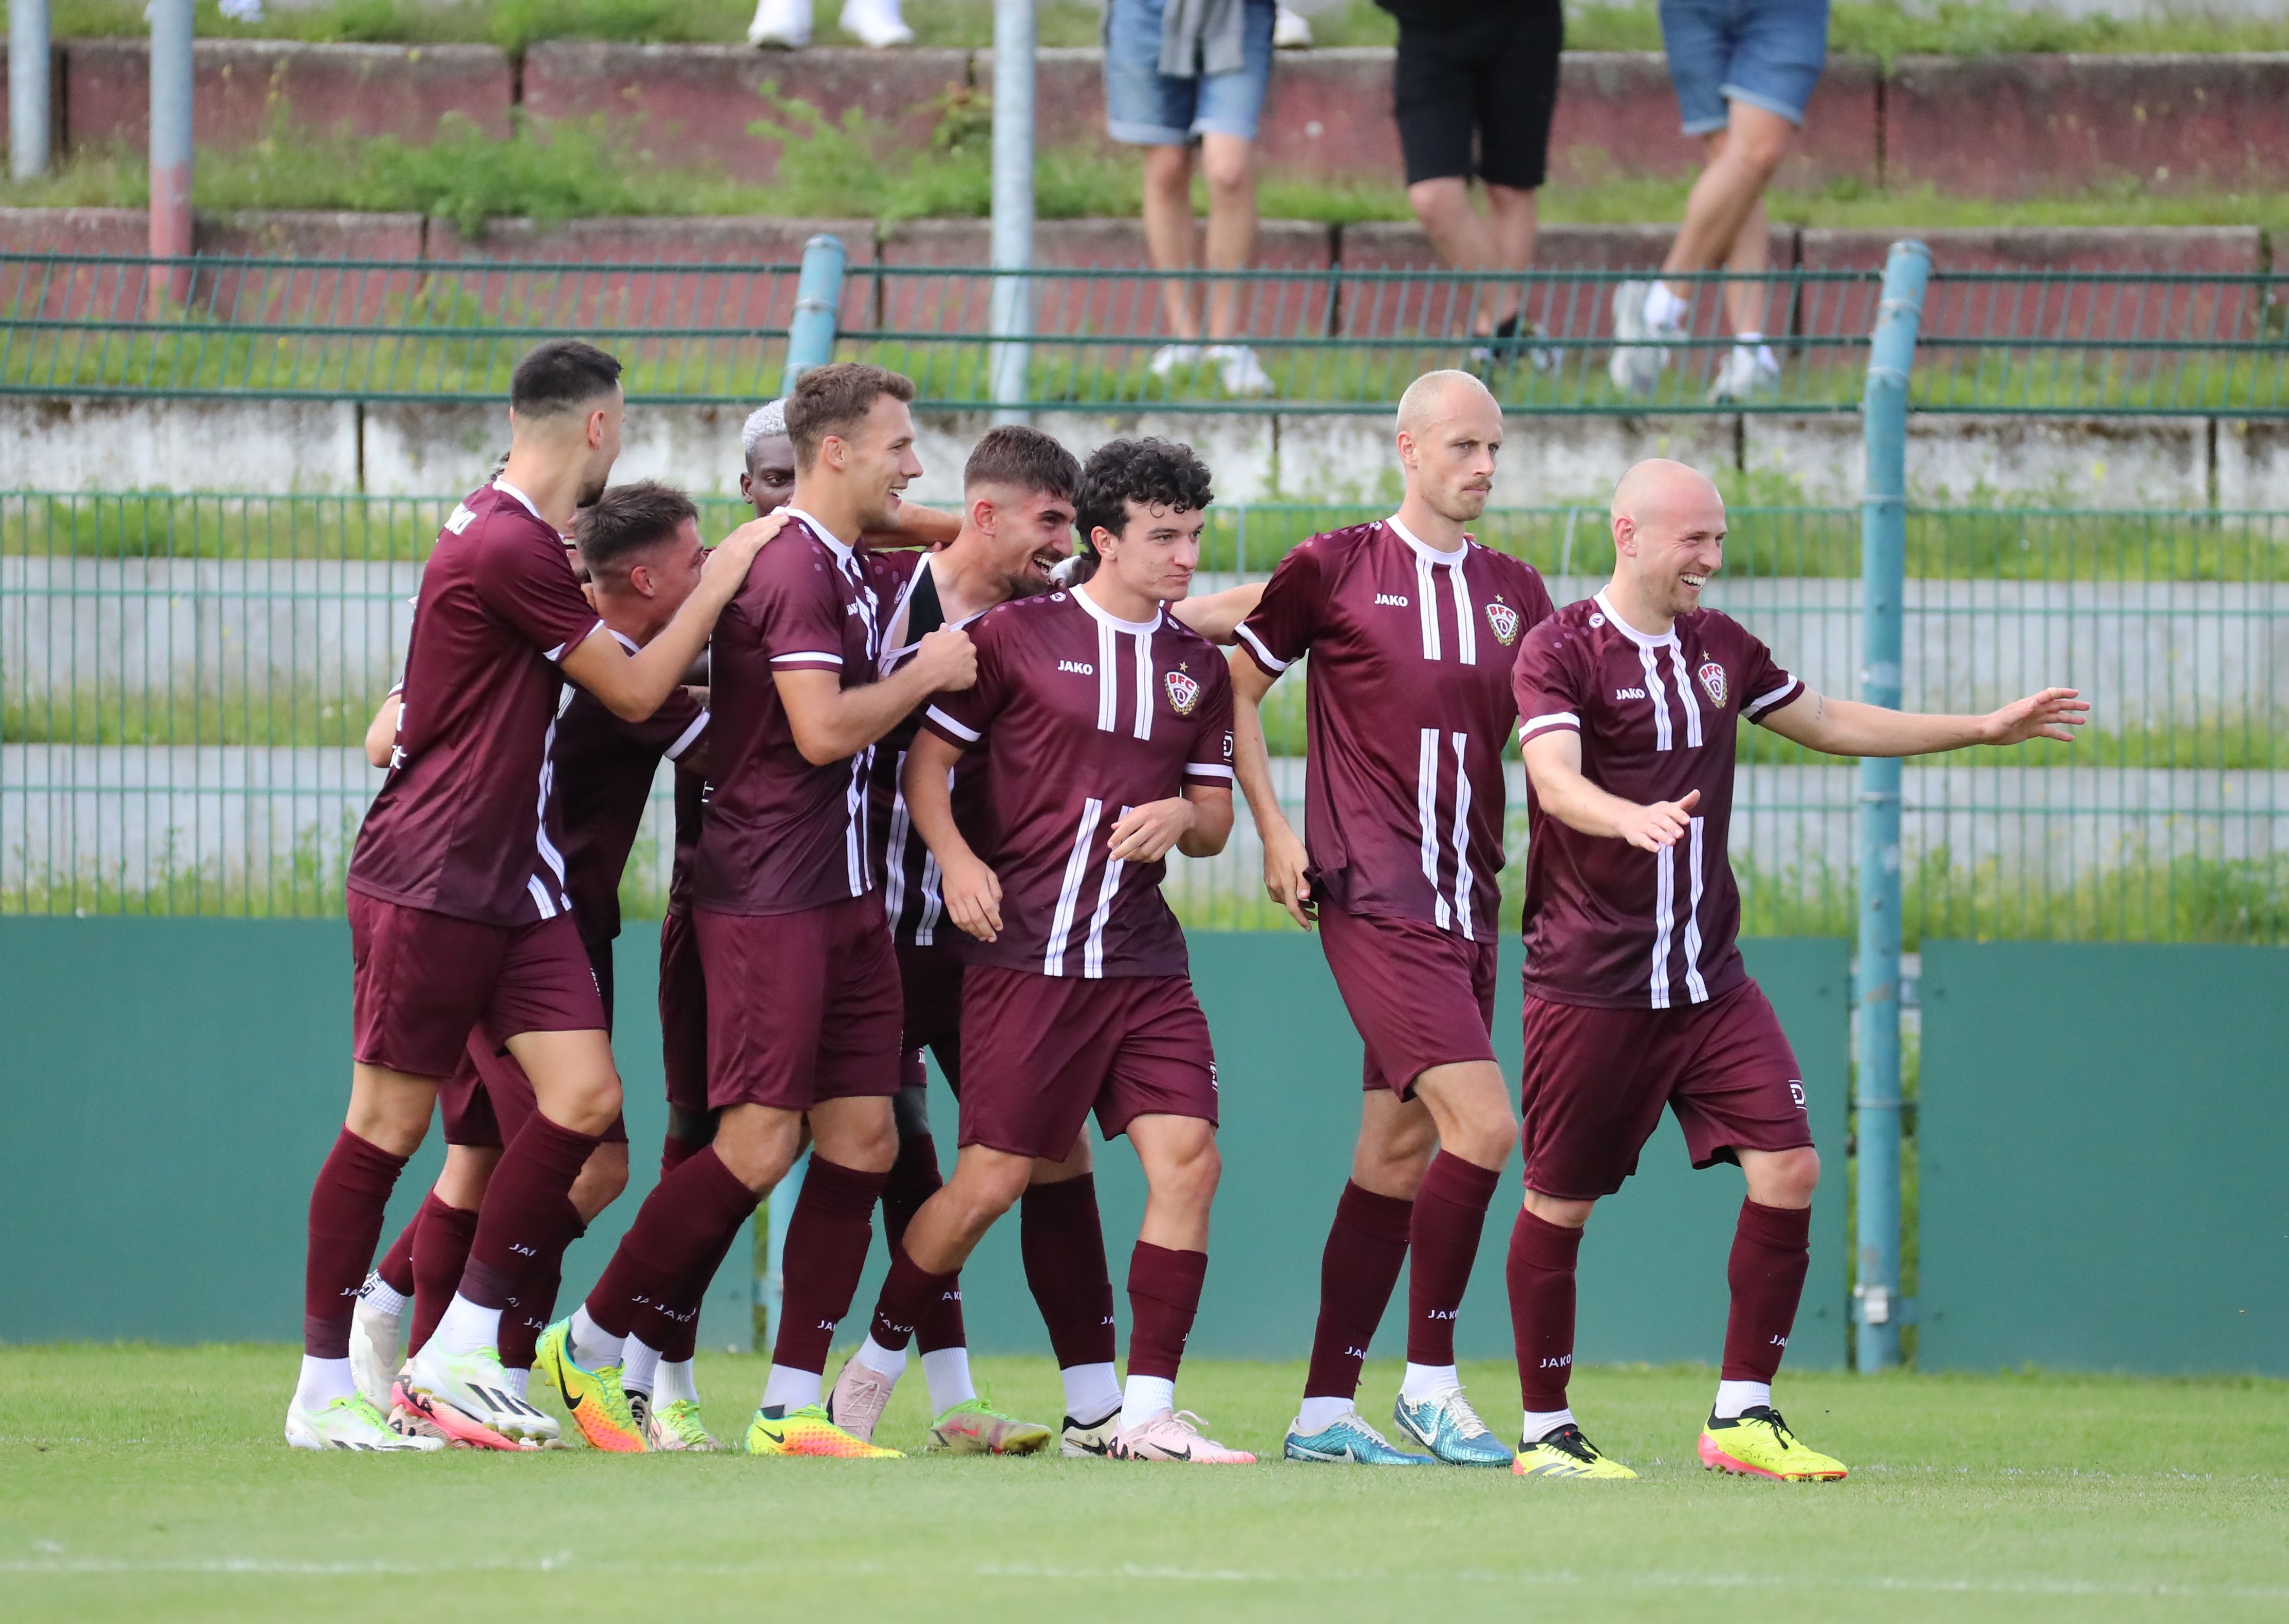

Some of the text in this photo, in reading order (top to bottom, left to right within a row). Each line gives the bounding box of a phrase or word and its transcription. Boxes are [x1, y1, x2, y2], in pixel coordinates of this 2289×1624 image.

[1374, 593, 1408, 607] JAKO
[1489, 606, 1514, 621] BFC
[1057, 660, 1093, 675] JAKO
[1701, 665, 1722, 680] BFC
[1169, 674, 1195, 691] BFC
[1616, 688, 1646, 700] JAKO
[1539, 1354, 1571, 1368] JAKO
